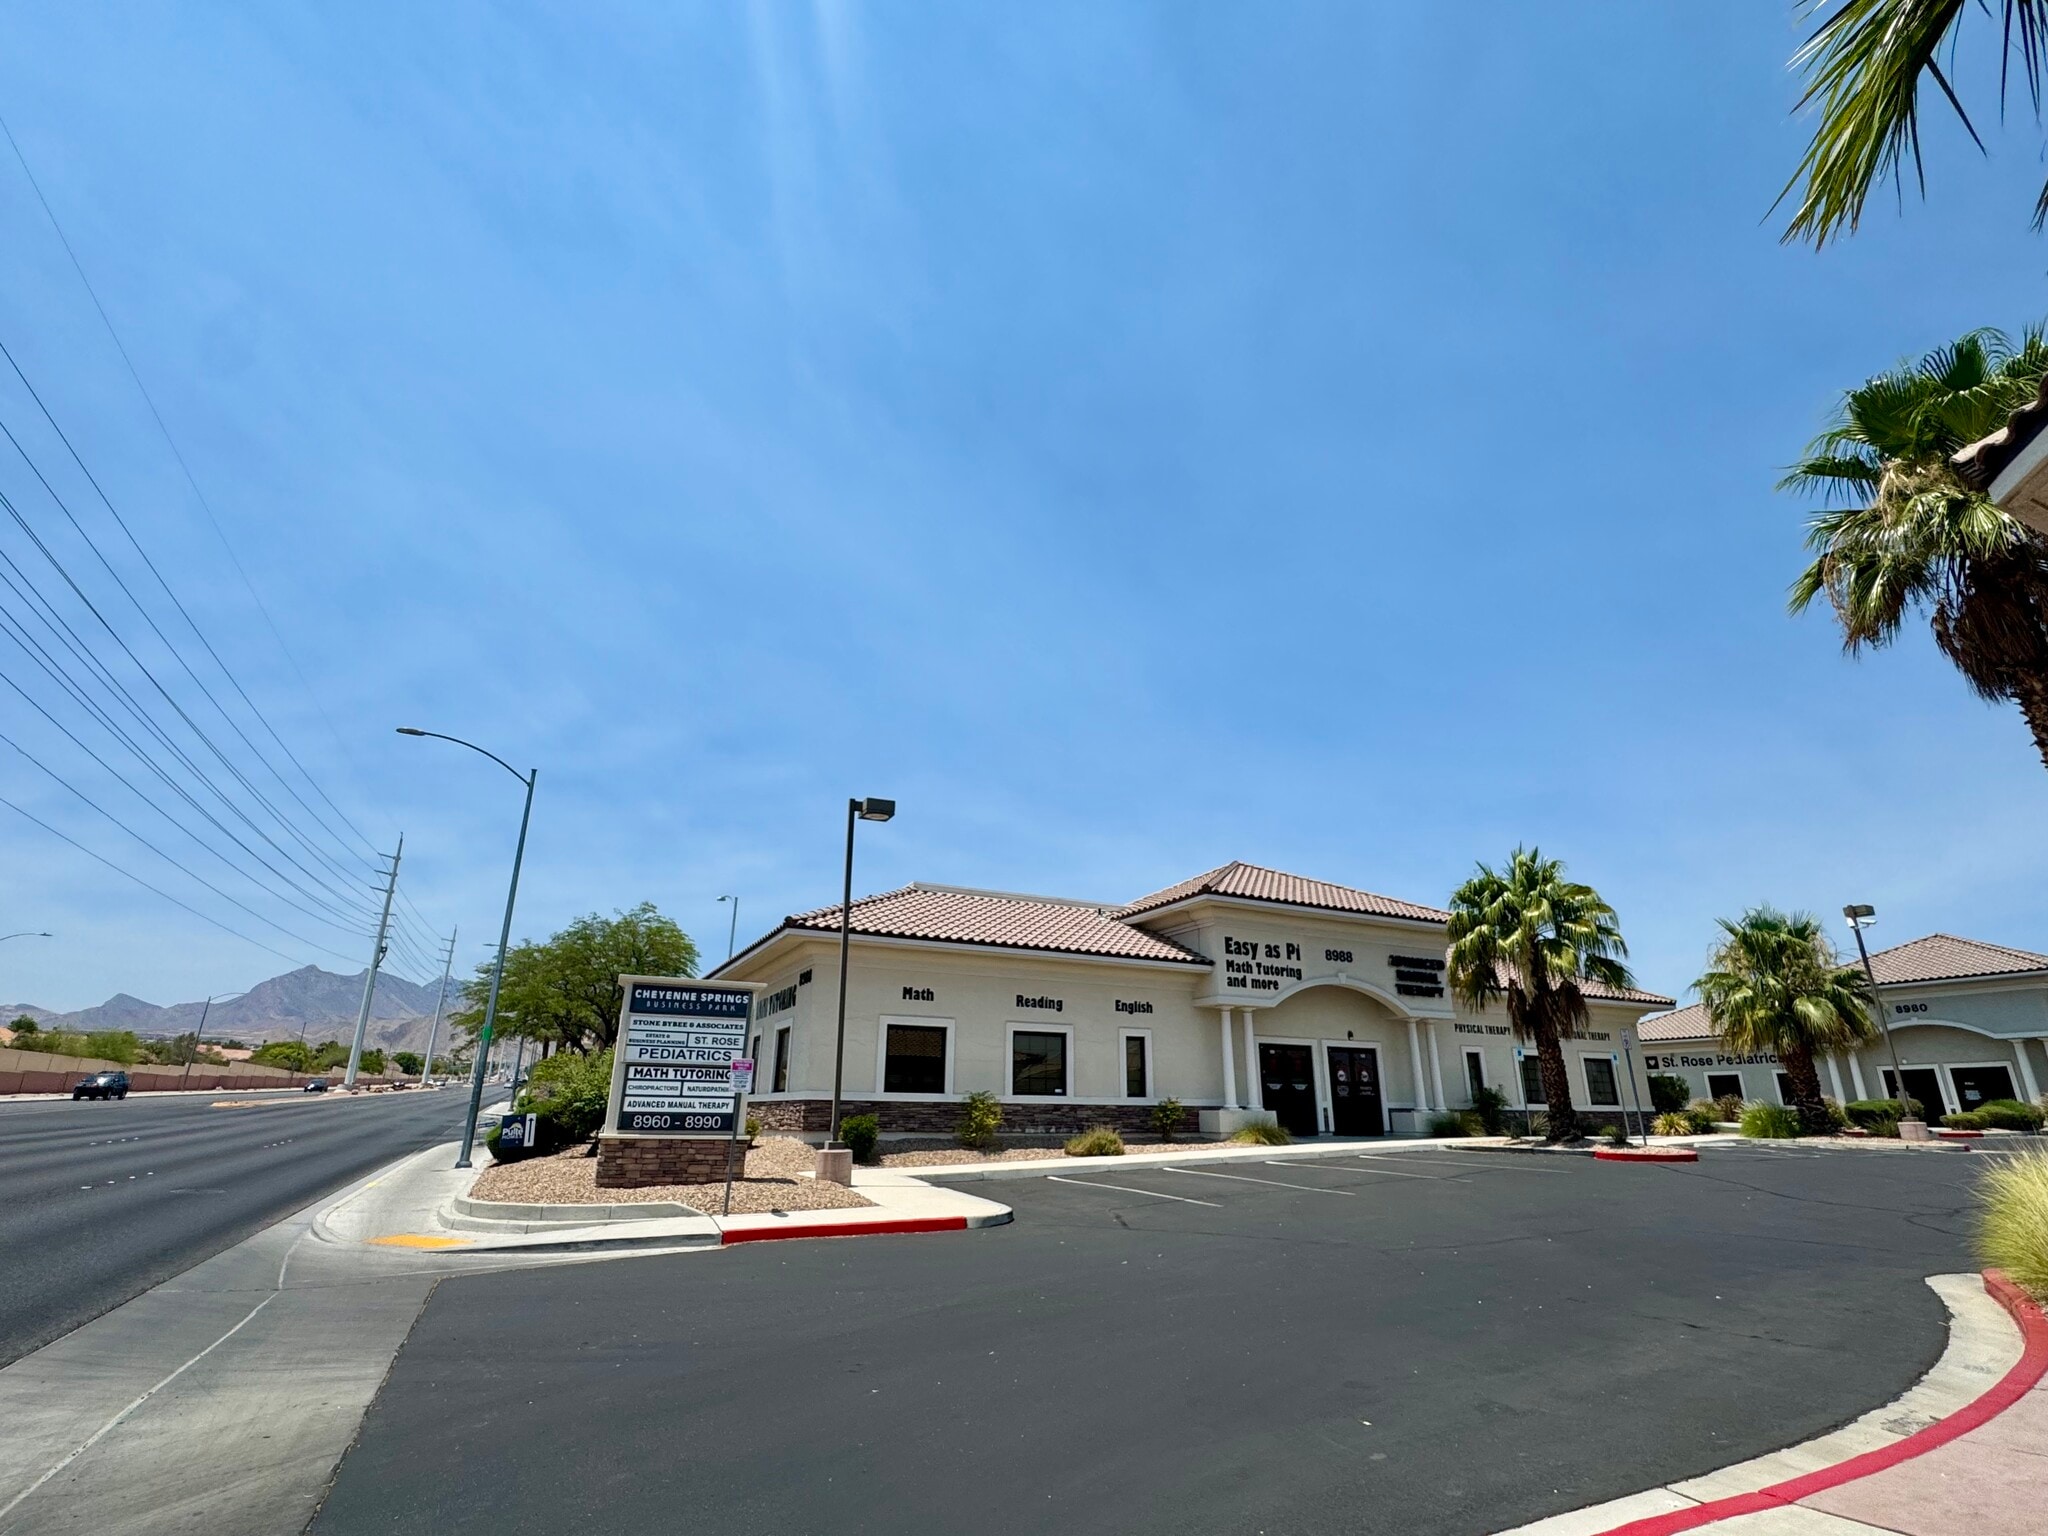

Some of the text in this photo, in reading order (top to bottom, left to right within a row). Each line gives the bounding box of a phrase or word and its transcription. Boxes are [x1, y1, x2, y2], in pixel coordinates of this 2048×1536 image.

[1224, 936, 1301, 961] Easy as Pi
[1325, 949, 1353, 962] 8988
[1226, 960, 1302, 980] Math Tutoring
[1227, 976, 1279, 990] and more
[635, 989, 749, 1004] CHEYENNE SPRINGS
[903, 986, 934, 1001] Math
[646, 1000, 701, 1010] BUSINESS
[1016, 994, 1063, 1012] Reading
[1115, 1000, 1153, 1014] English
[1896, 1003, 1928, 1014] 8980
[633, 1019, 661, 1027] STONE
[662, 1020, 688, 1028] BYBEE
[695, 1022, 744, 1030] ASSOCIATES
[1454, 1023, 1511, 1036] PHYSICAL THERAPY
[694, 1036, 740, 1047] ST. ROSE
[1588, 1031, 1611, 1041] THERAPY
[638, 1048, 732, 1062] PEDIATRICS
[1662, 1052, 1783, 1068] St. Rose Pediatric
[633, 1068, 669, 1079] MATH
[627, 1101, 730, 1110] ADVANCED MANUAL THERAPY
[633, 1115, 671, 1129] 8960
[685, 1115, 721, 1129] 8990
